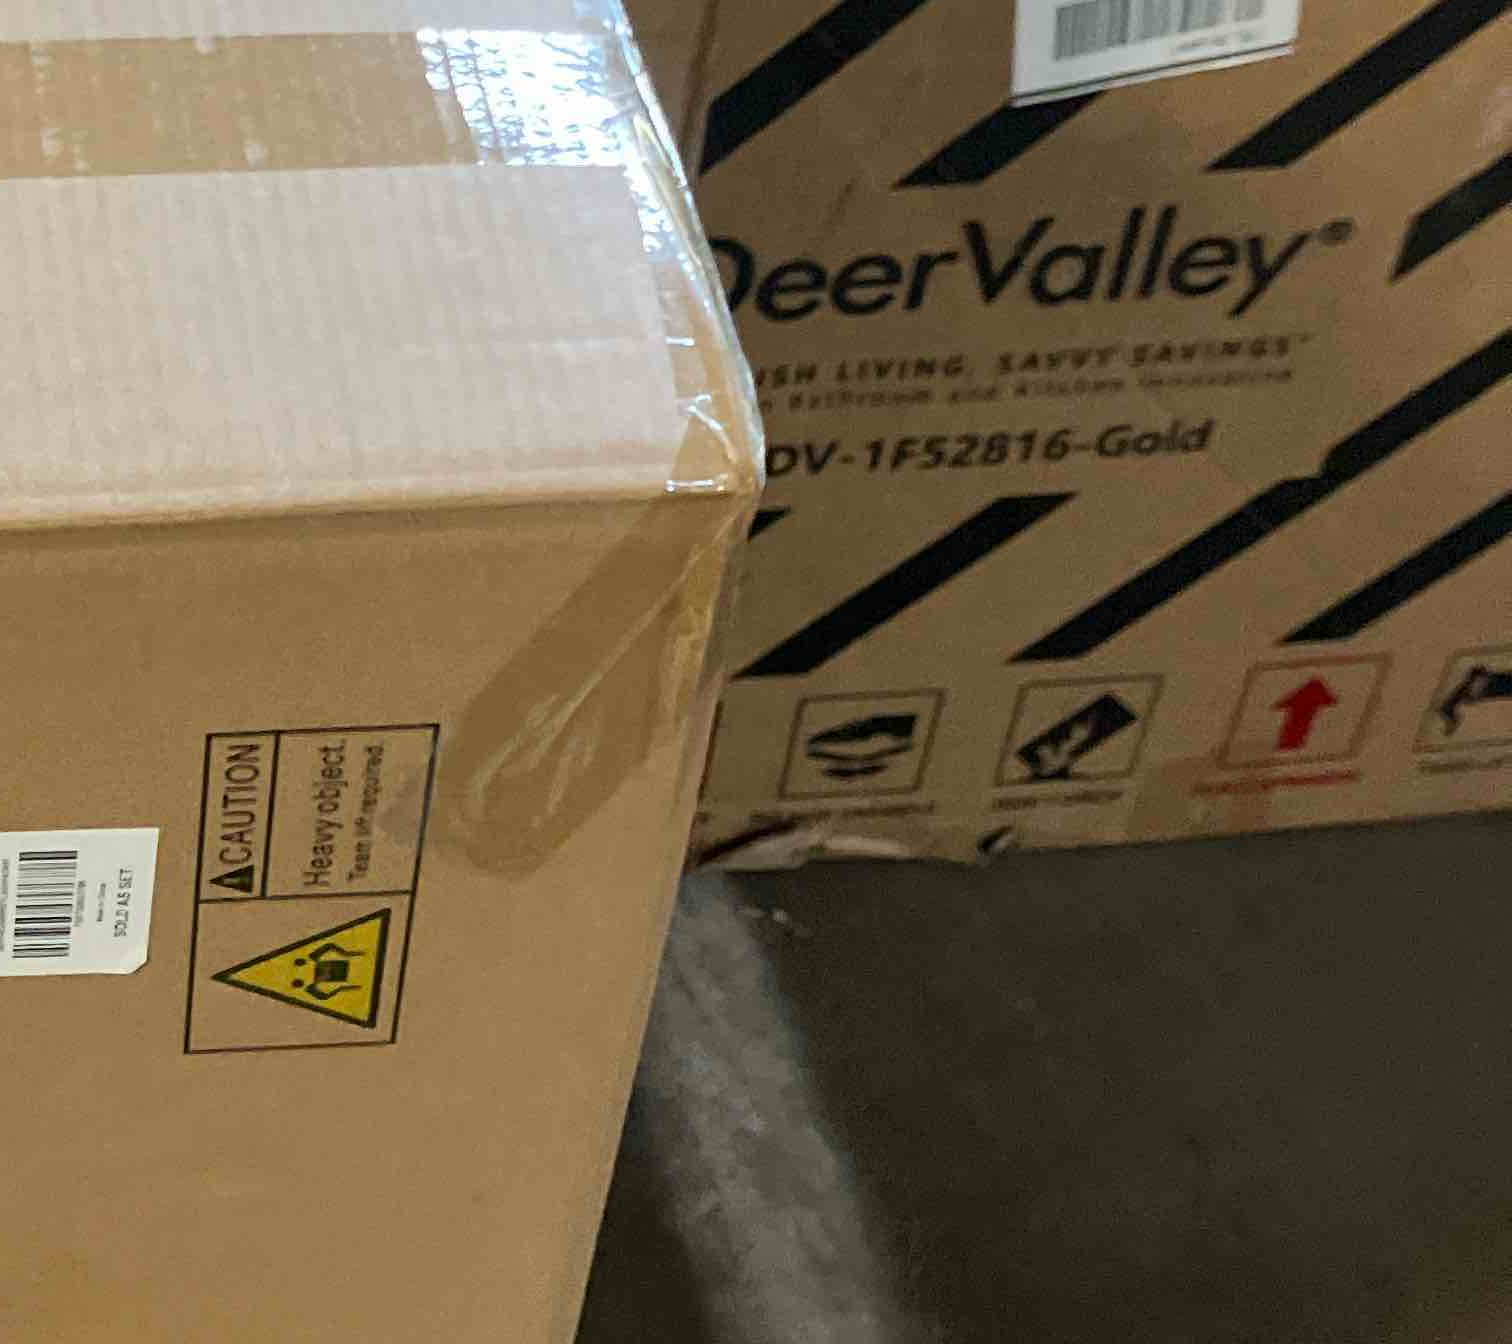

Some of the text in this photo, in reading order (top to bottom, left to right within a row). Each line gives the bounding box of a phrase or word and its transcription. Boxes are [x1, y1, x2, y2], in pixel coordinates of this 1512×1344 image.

[218, 743, 261, 865] CAUTION
[303, 739, 348, 888] Heavy object.
[113, 868, 134, 938] SOLD AS SET
